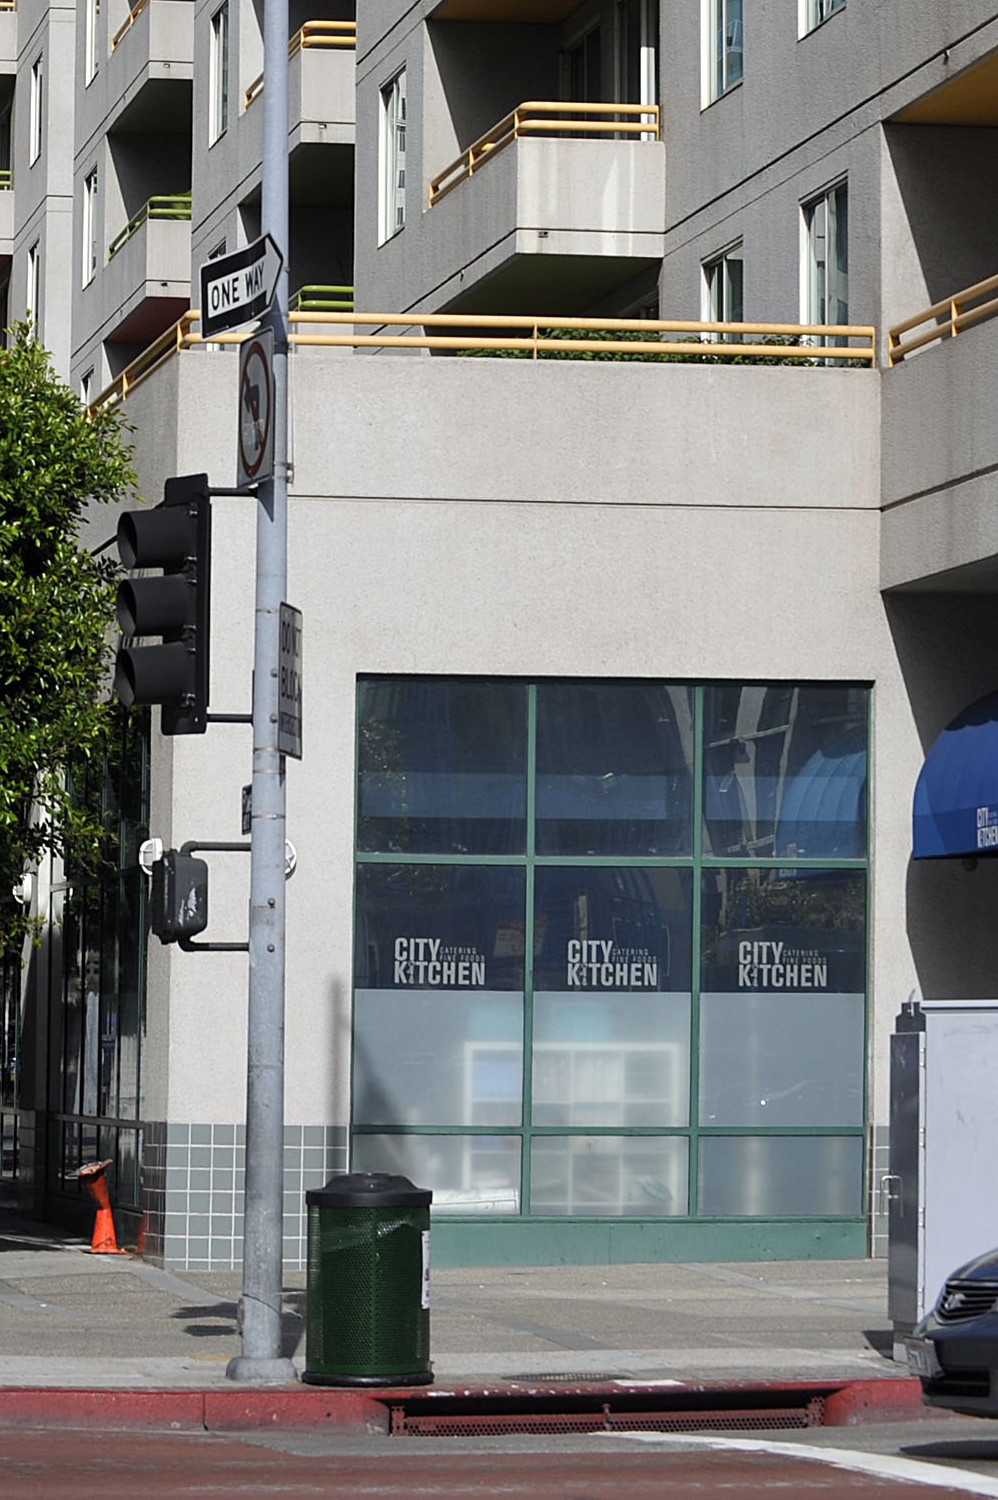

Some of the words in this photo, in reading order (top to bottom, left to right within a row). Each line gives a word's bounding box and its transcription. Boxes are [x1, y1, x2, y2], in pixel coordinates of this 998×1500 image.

[212, 276, 239, 311] ONE
[245, 261, 264, 298] WAY
[395, 937, 441, 961] CITY
[568, 940, 613, 963] CITY
[739, 941, 783, 964] CITY
[394, 961, 485, 985] KITCHEN
[568, 963, 657, 986] KITCHEN
[739, 964, 827, 987] KITCHEN
